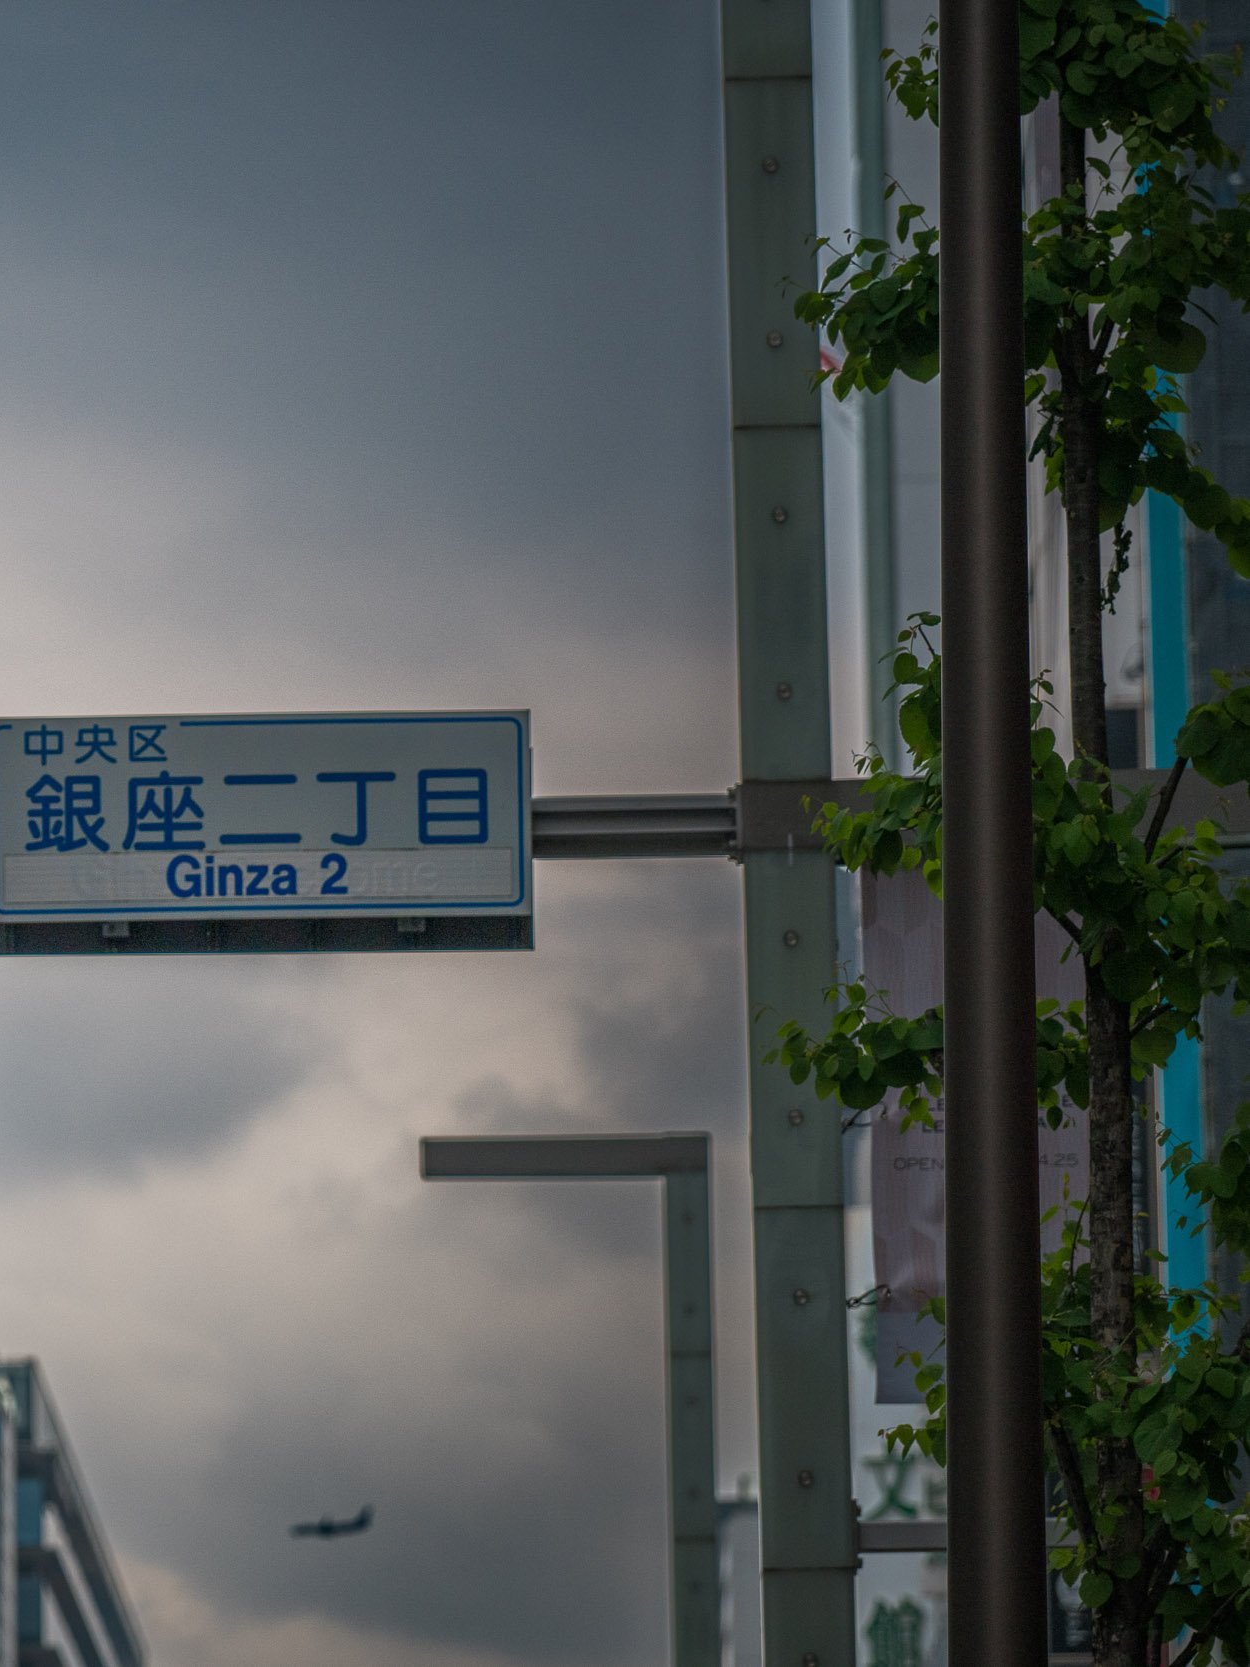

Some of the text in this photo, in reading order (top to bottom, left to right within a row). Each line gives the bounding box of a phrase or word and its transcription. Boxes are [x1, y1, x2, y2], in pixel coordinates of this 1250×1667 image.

[23, 723, 168, 765] 中央区
[24, 768, 489, 852] 銀座二丁目
[166, 854, 297, 898] Ginza
[321, 852, 348, 896] 2
